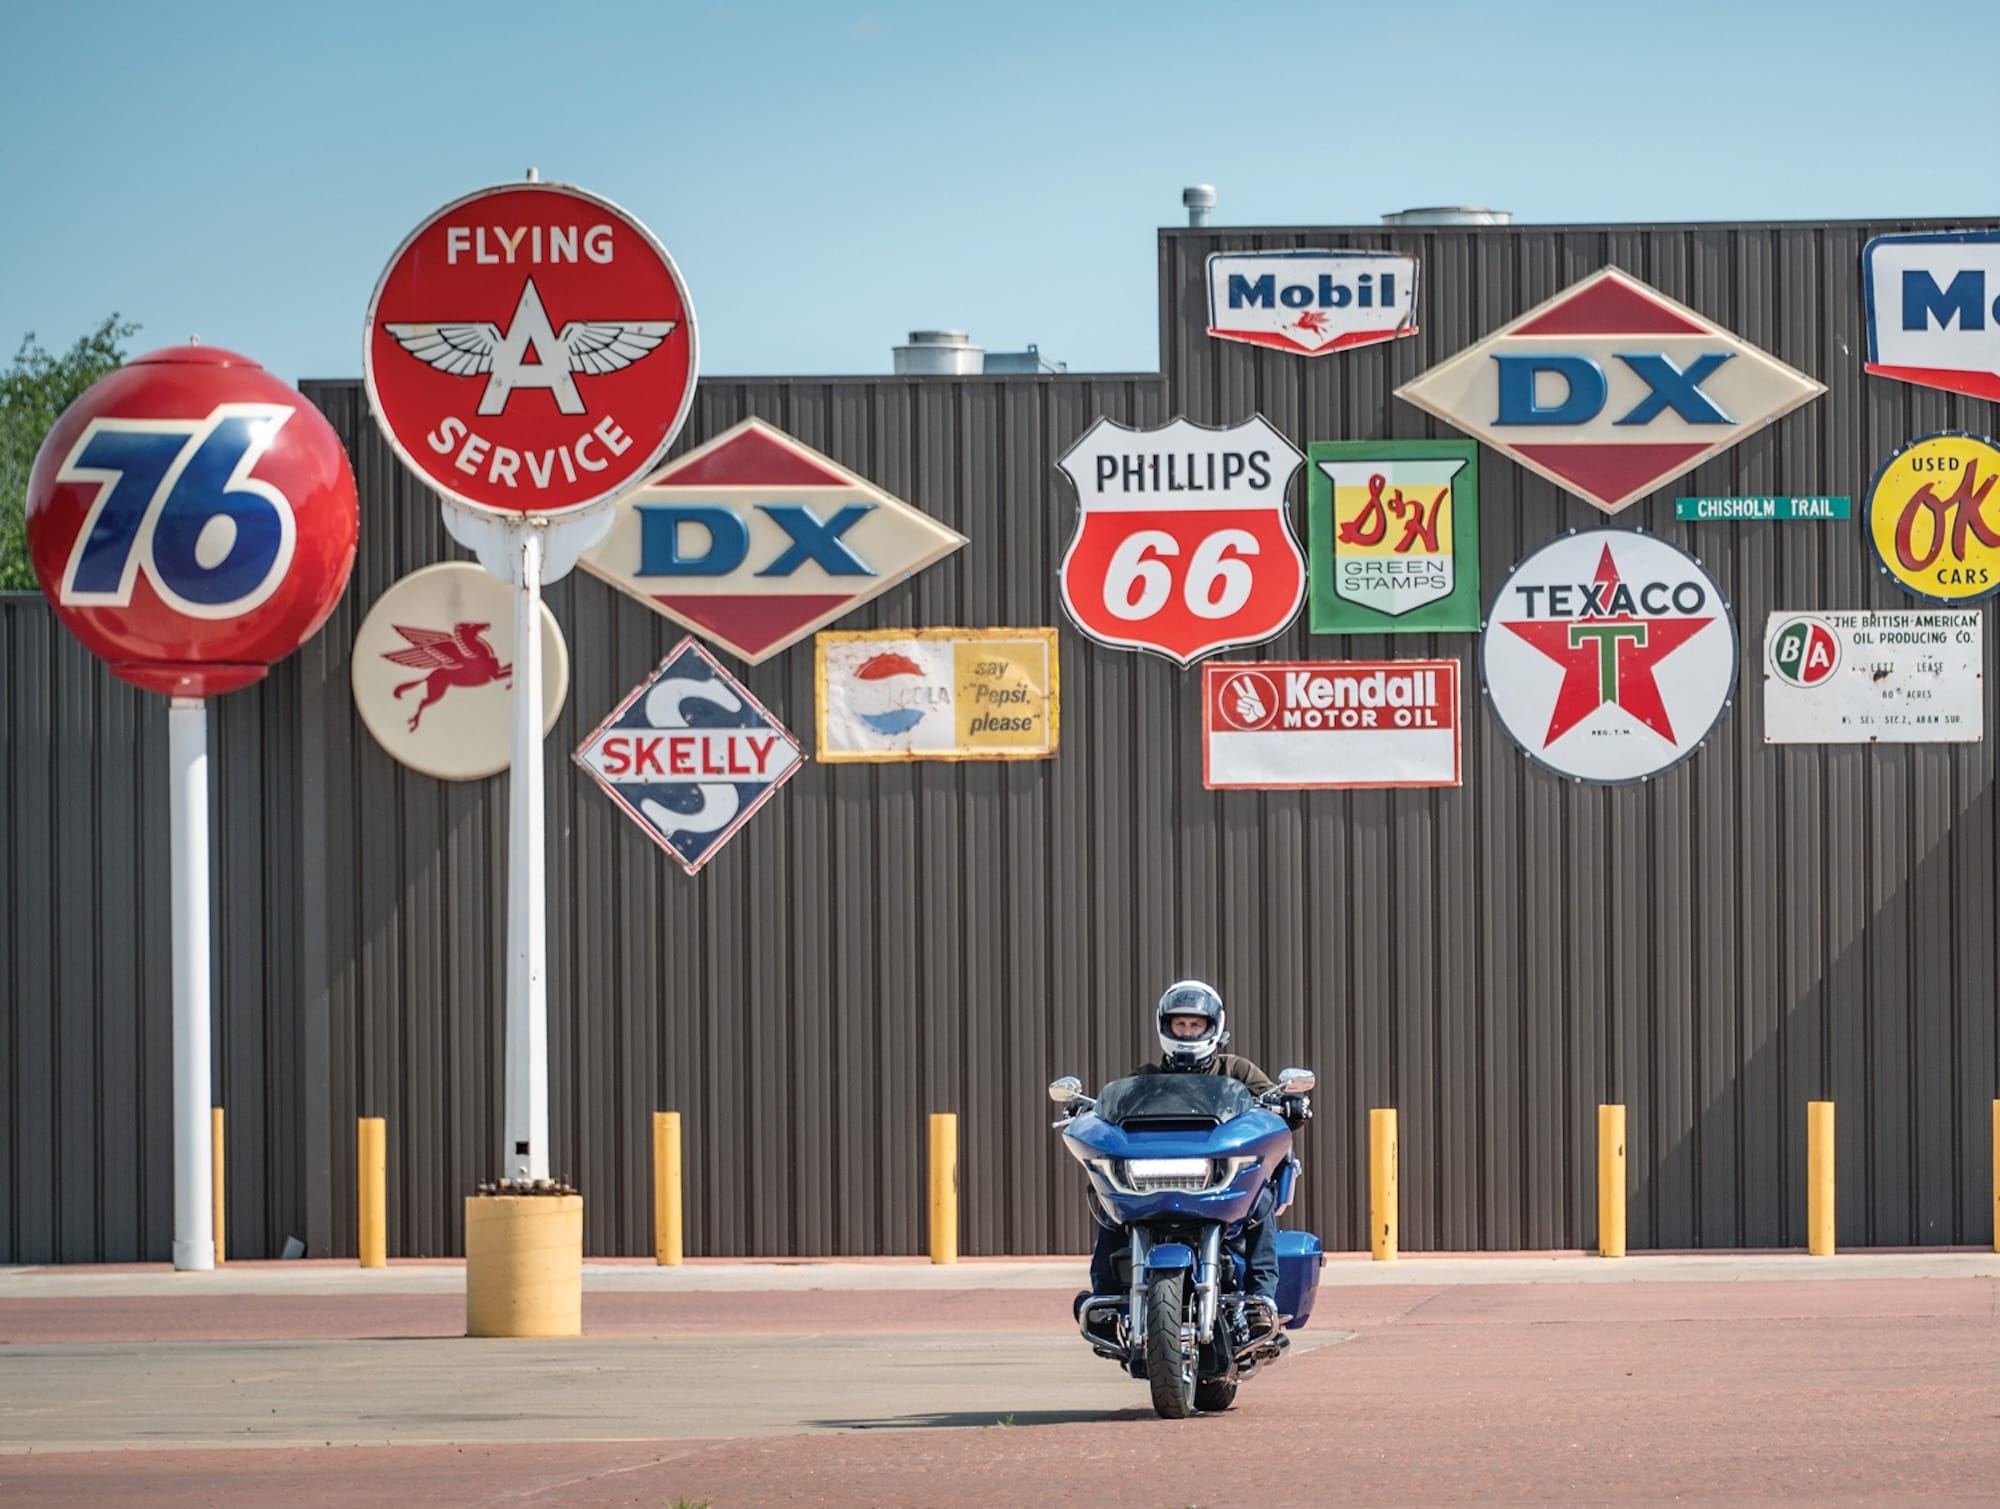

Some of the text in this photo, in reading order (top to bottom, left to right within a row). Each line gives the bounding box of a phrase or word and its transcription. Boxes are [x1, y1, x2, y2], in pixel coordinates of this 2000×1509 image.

[447, 225, 614, 264] FLYING
[1229, 272, 1395, 309] Mobil
[1902, 270, 2000, 330] M
[476, 273, 588, 416] A
[1490, 353, 1739, 426] DX
[427, 415, 634, 489] SERVICE
[1912, 457, 1959, 472] USED
[1096, 450, 1272, 493] PHILLIPS
[57, 403, 297, 620] 76
[1338, 474, 1449, 553] S&H
[1697, 499, 1776, 518] CHISHOLM
[1790, 498, 1835, 516] TRAIL
[1895, 458, 2000, 572] OK
[633, 504, 880, 577] DX
[1103, 529, 1261, 621] 66
[1344, 560, 1445, 576] GREEN
[1344, 575, 1447, 591] STAMPS
[1936, 568, 1989, 585] CARS
[1515, 581, 1706, 619] TEXACO
[1834, 614, 1978, 628] THE BRITISH-AMERICAN
[1853, 632, 1874, 645] OIL
[1879, 631, 1948, 644] PRODUCING
[1568, 621, 1649, 705] T
[1780, 635, 1830, 669] B A
[1917, 661, 1944, 673] LEASE
[974, 661, 1010, 682] say
[1285, 671, 1436, 708] Kendall
[1906, 689, 1932, 699] ACRES
[969, 712, 1041, 736] please"
[1283, 708, 1438, 728] MOTOR OIL
[602, 736, 777, 775] SKELLY
